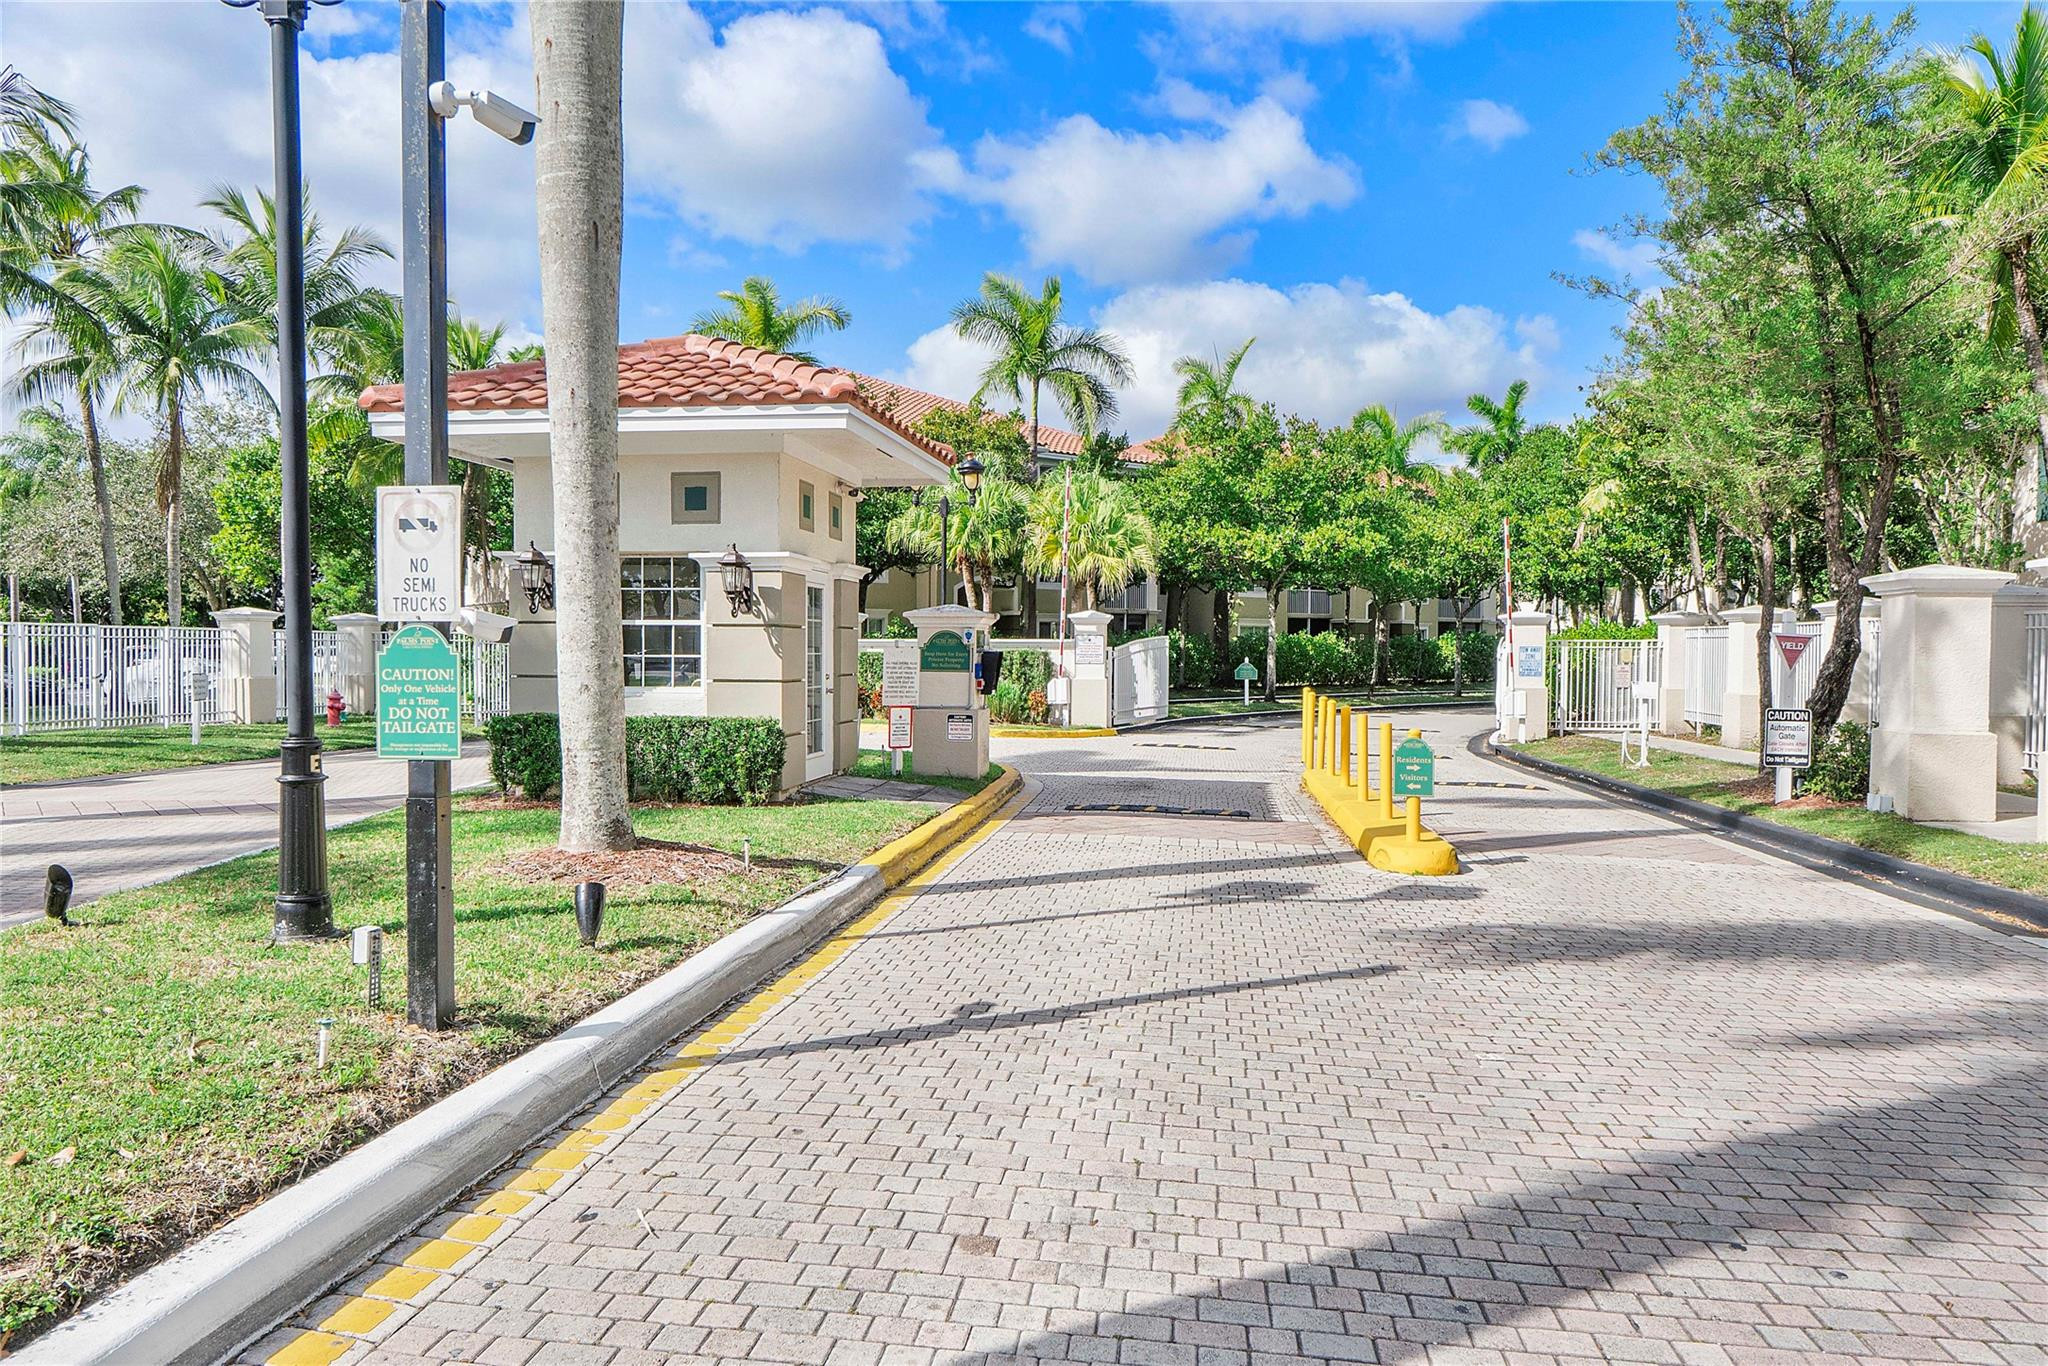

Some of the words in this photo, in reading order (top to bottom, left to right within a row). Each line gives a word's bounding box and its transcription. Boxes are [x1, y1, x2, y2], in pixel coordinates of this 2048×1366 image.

[410, 558, 429, 573] NO
[403, 577, 435, 592] SEMI
[392, 597, 447, 612] TRUCKS
[1781, 641, 1804, 650] YIELD
[382, 668, 454, 681] CAUTION!
[381, 684, 403, 694] Only
[404, 684, 423, 693] One
[424, 684, 457, 693] Vehicle
[398, 697, 407, 706] at
[409, 698, 415, 706] a
[416, 697, 440, 706] Time
[389, 706, 412, 719] DO
[415, 706, 450, 720] NOT
[1768, 711, 1809, 721] CAUTION
[381, 721, 456, 734] TAILGATE
[1769, 724, 1805, 732] Automatic
[1778, 732, 1796, 740] Gate
[1785, 756, 1808, 764] Tailgate
